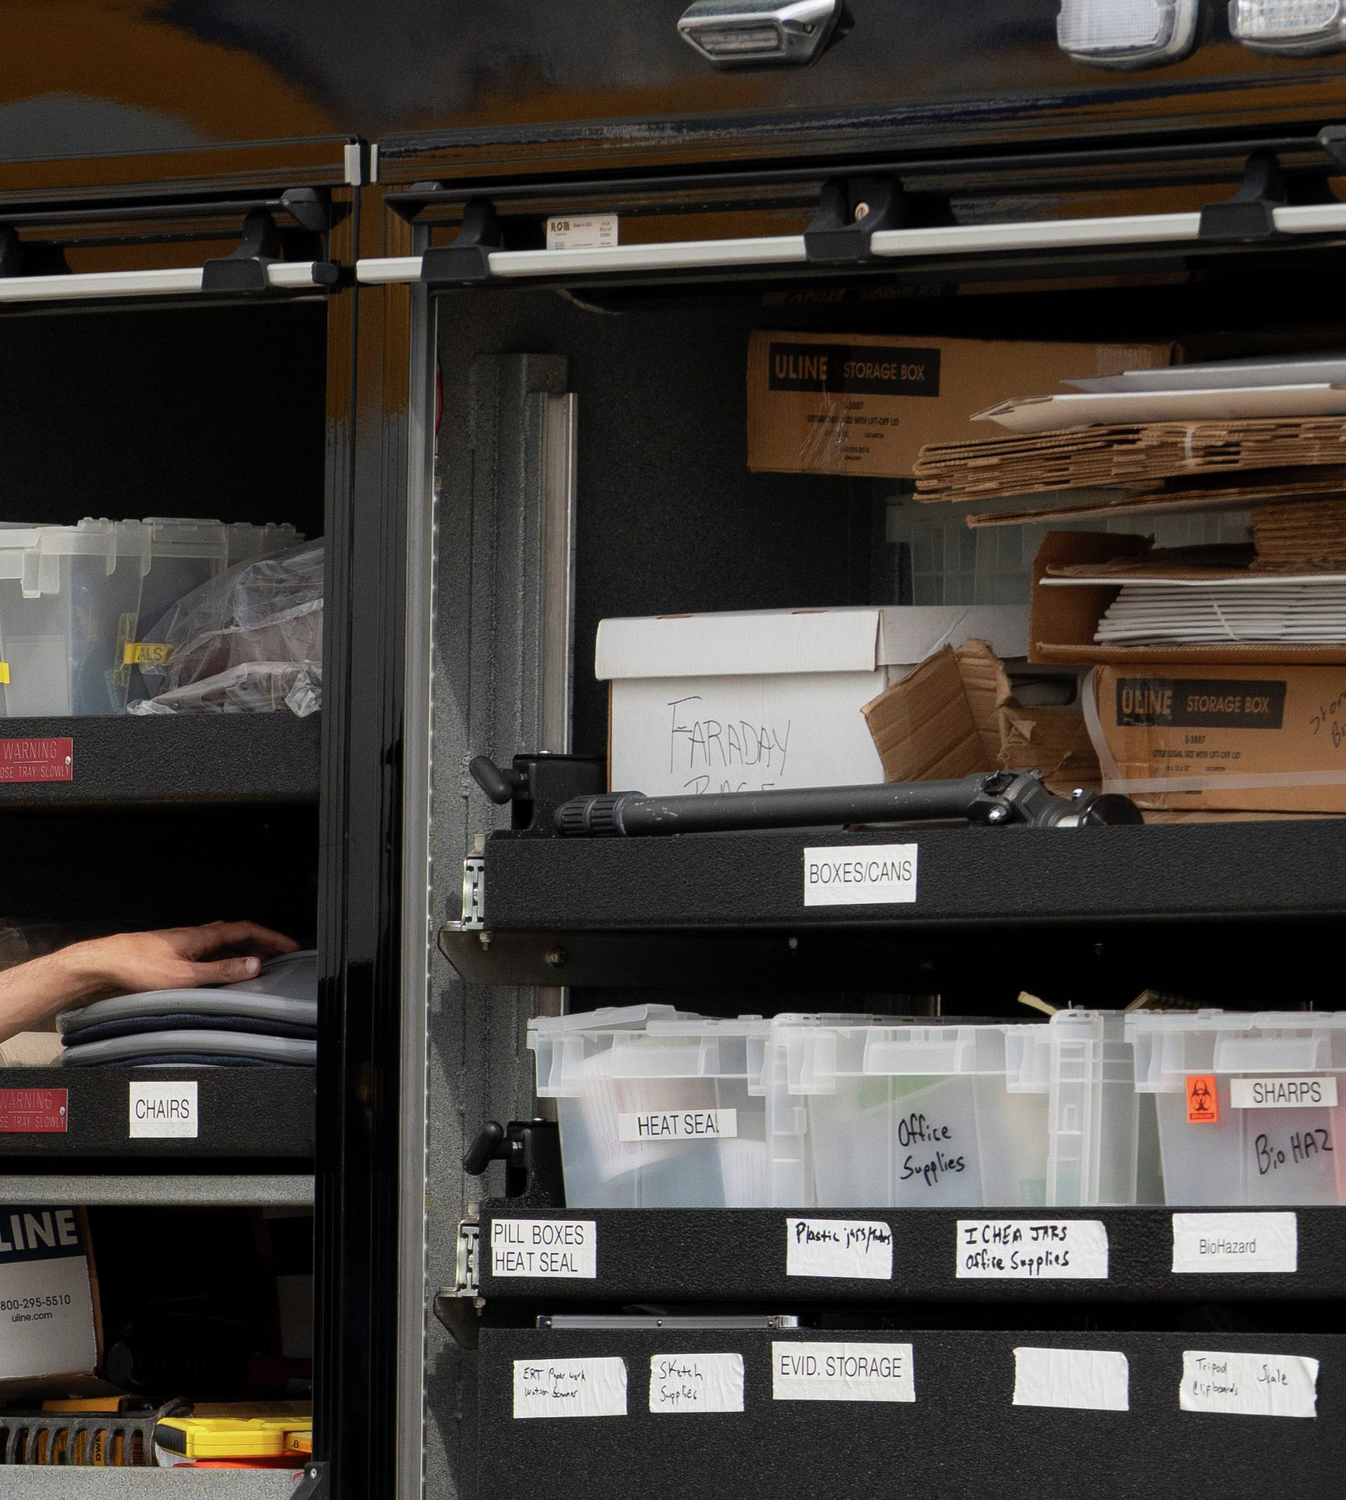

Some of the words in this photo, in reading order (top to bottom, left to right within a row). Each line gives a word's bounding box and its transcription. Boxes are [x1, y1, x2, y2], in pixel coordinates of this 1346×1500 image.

[775, 355, 828, 380] ULINE
[843, 362, 897, 380] STORAGE
[900, 364, 925, 381] BOX
[138, 647, 163, 661] ALS
[1121, 686, 1173, 714] ULINE
[1186, 695, 1241, 712] STORAGE
[1244, 697, 1270, 713] BOX
[667, 696, 791, 776] FARADAY
[3, 741, 58, 760] WARNING
[18, 766, 36, 778] TRAY
[40, 765, 70, 778] SLOWLY
[810, 861, 912, 883] BOXES/CANS
[1253, 1082, 1322, 1103] SHARPS
[135, 1099, 191, 1119] CHAIRS
[12, 1115, 31, 1129] TRAY
[34, 1115, 65, 1129] SLOWLY
[637, 1115, 679, 1136] HEAT
[683, 1113, 720, 1135] SEAL
[897, 1113, 952, 1148] Office
[1255, 1134, 1285, 1175] Bio
[899, 1151, 966, 1187] Supplies
[494, 1223, 524, 1243] PILL
[532, 1225, 584, 1245] BOXES
[795, 1221, 840, 1244] Plastic
[1199, 1238, 1256, 1254] BioHazard
[495, 1251, 535, 1271] HEAT
[539, 1252, 578, 1272] SEAL
[966, 1249, 1005, 1270] Office
[1010, 1250, 1070, 1276] Supplies
[11, 1311, 52, 1322] uline.com
[523, 1367, 544, 1380] ERT
[781, 1356, 821, 1376] EVID.
[826, 1356, 902, 1377] STORAGE
[1196, 1358, 1227, 1376] Tripod
